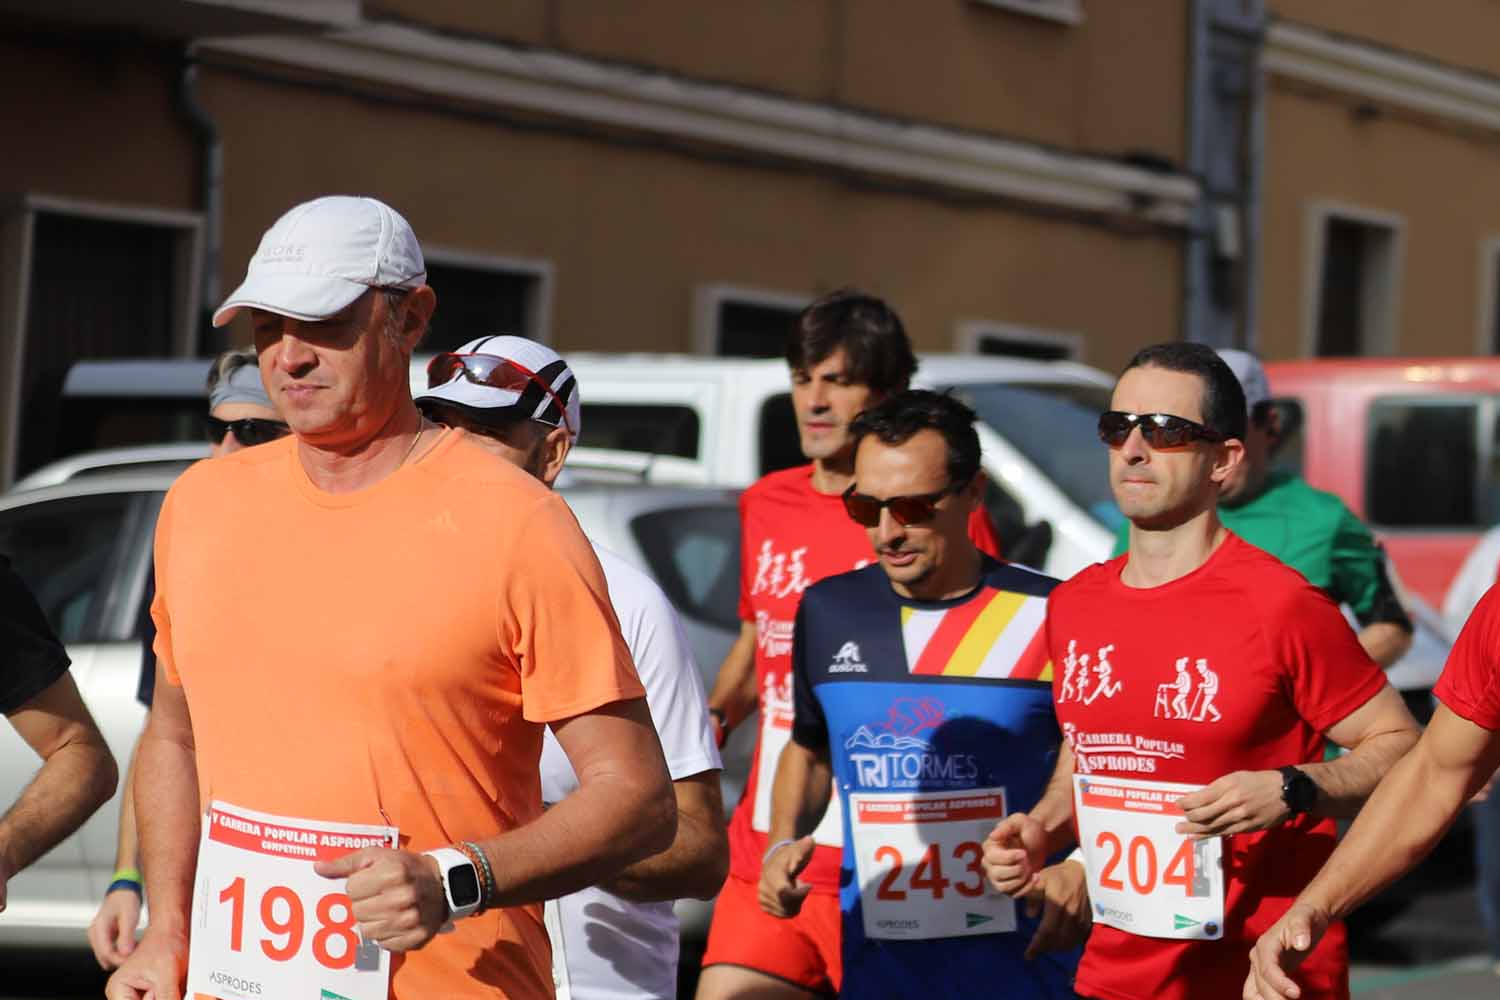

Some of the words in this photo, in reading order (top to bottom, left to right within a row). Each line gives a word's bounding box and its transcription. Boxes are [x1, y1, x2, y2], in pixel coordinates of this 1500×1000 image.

[1077, 732, 1131, 745] CARRERA
[1135, 735, 1184, 754] POPULAR
[1078, 754, 1156, 773] ASPRODES
[220, 817, 261, 837] CARRERA
[264, 827, 317, 844] POPULAR
[320, 835, 384, 849] ASPRODES
[261, 841, 316, 856] COMPETITIVA
[874, 841, 985, 901] 243
[1095, 831, 1194, 897] 204
[219, 877, 360, 970] 198
[210, 971, 262, 995] ASPRODES
